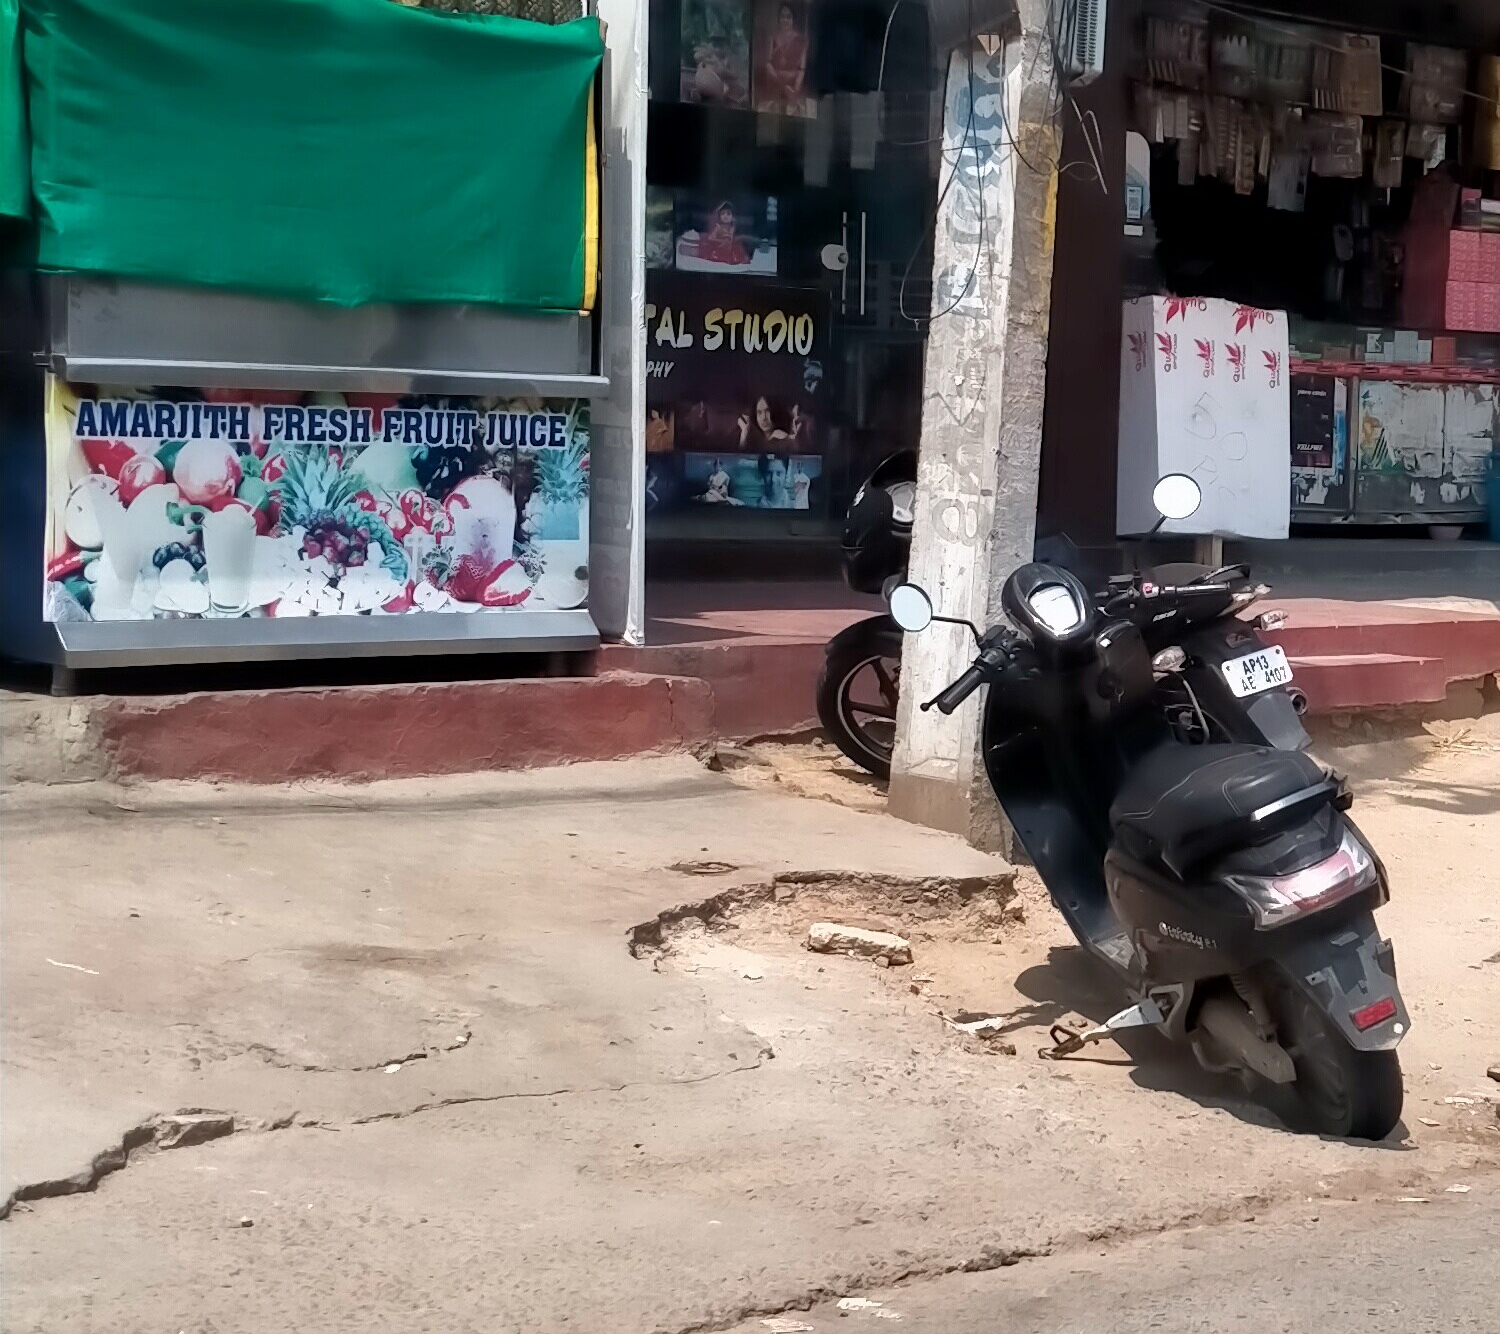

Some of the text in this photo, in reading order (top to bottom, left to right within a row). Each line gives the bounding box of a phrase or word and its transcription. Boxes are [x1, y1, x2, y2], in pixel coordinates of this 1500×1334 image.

[703, 306, 814, 357] STUDIO
[74, 398, 569, 450] AMARJITH FRESH FRUIT JUICE
[1242, 654, 1269, 676] AP13
